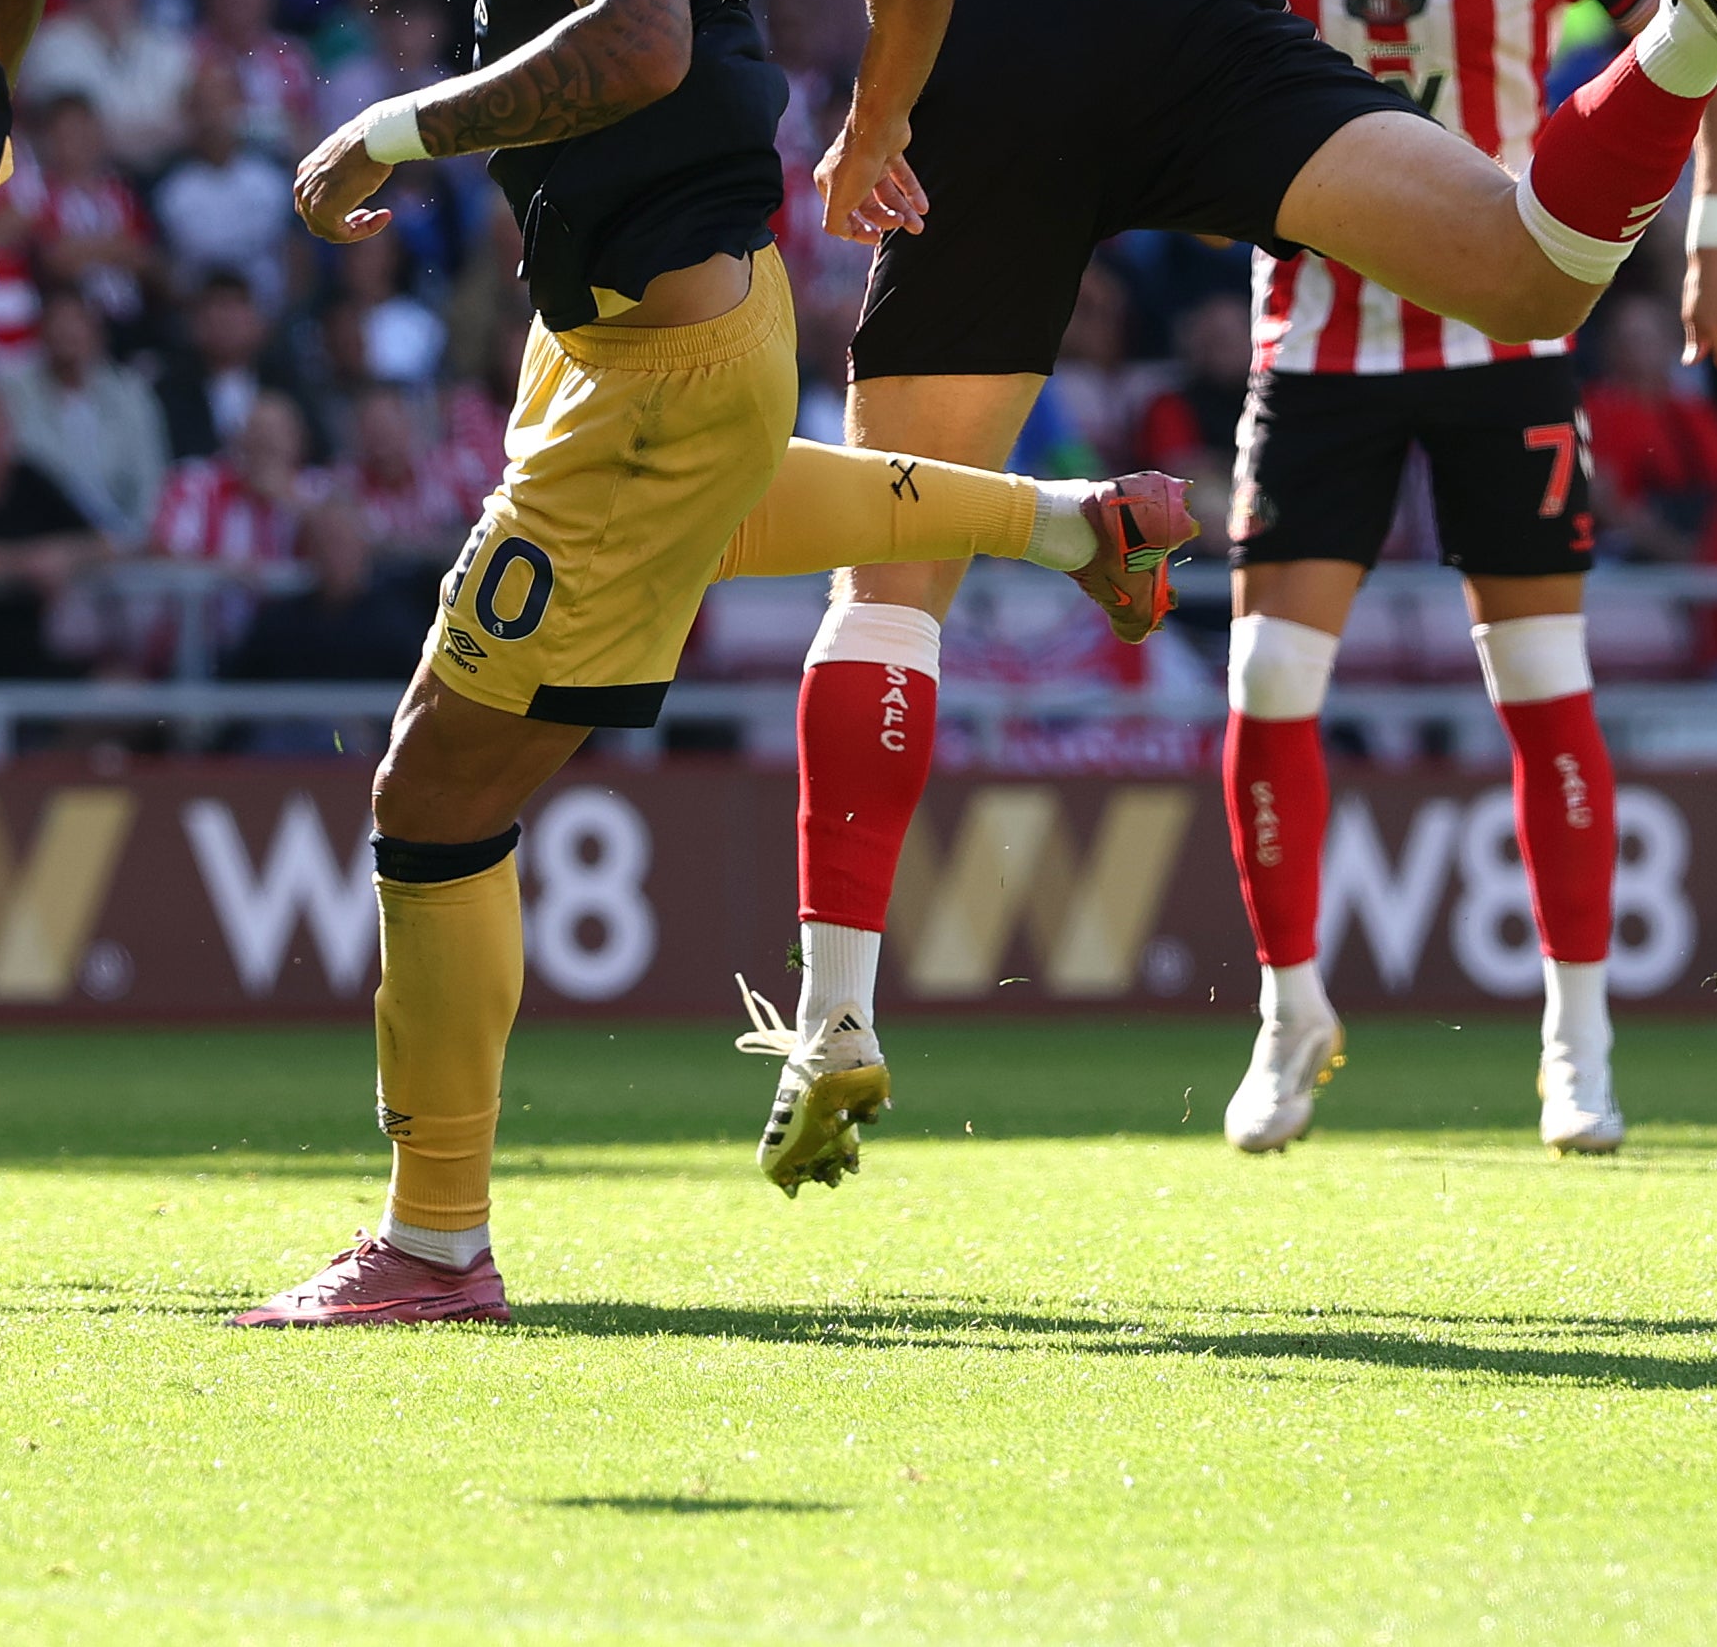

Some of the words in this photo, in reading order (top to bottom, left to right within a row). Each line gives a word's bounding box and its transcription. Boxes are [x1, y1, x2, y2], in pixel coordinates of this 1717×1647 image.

[1523, 422, 1575, 519] 7
[880, 664, 909, 752] SAFC
[180, 783, 659, 1005] W8
